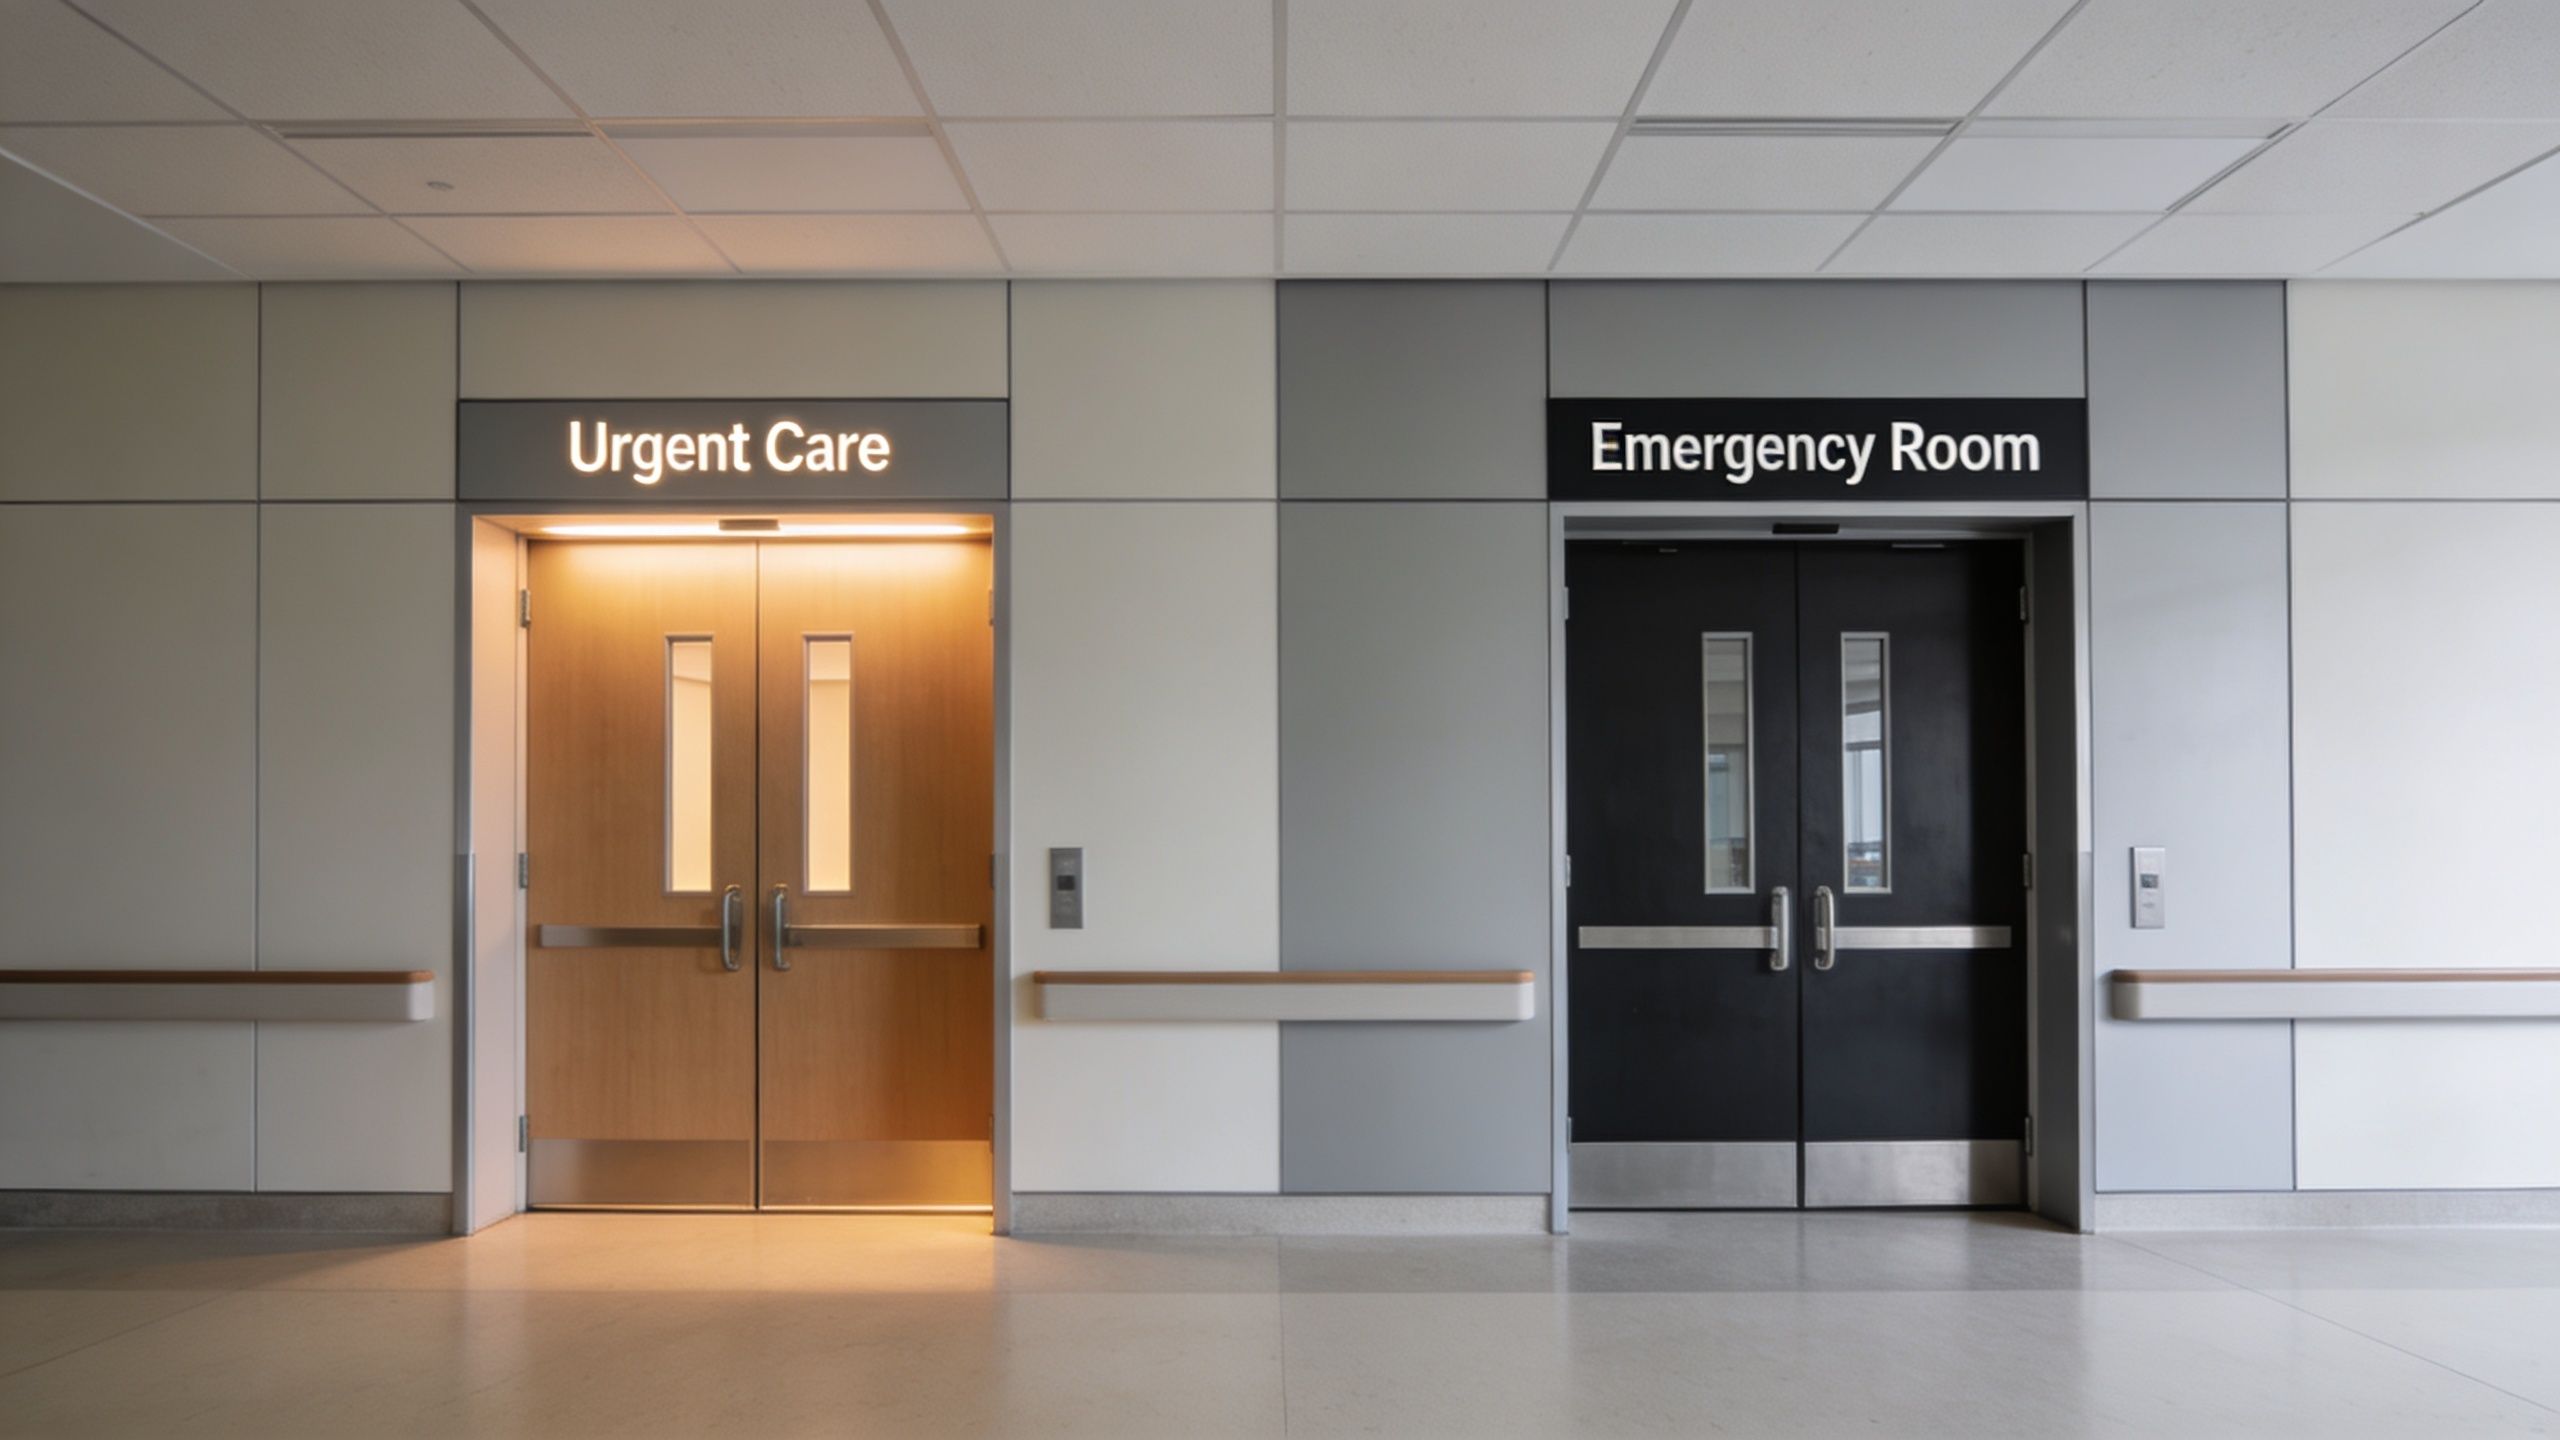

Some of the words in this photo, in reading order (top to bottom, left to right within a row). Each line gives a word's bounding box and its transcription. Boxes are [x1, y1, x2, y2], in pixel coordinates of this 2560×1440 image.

[569, 420, 751, 485] Urgent
[765, 419, 891, 472] Care
[1592, 422, 1875, 484] Emergency
[1891, 421, 2040, 471] Room
